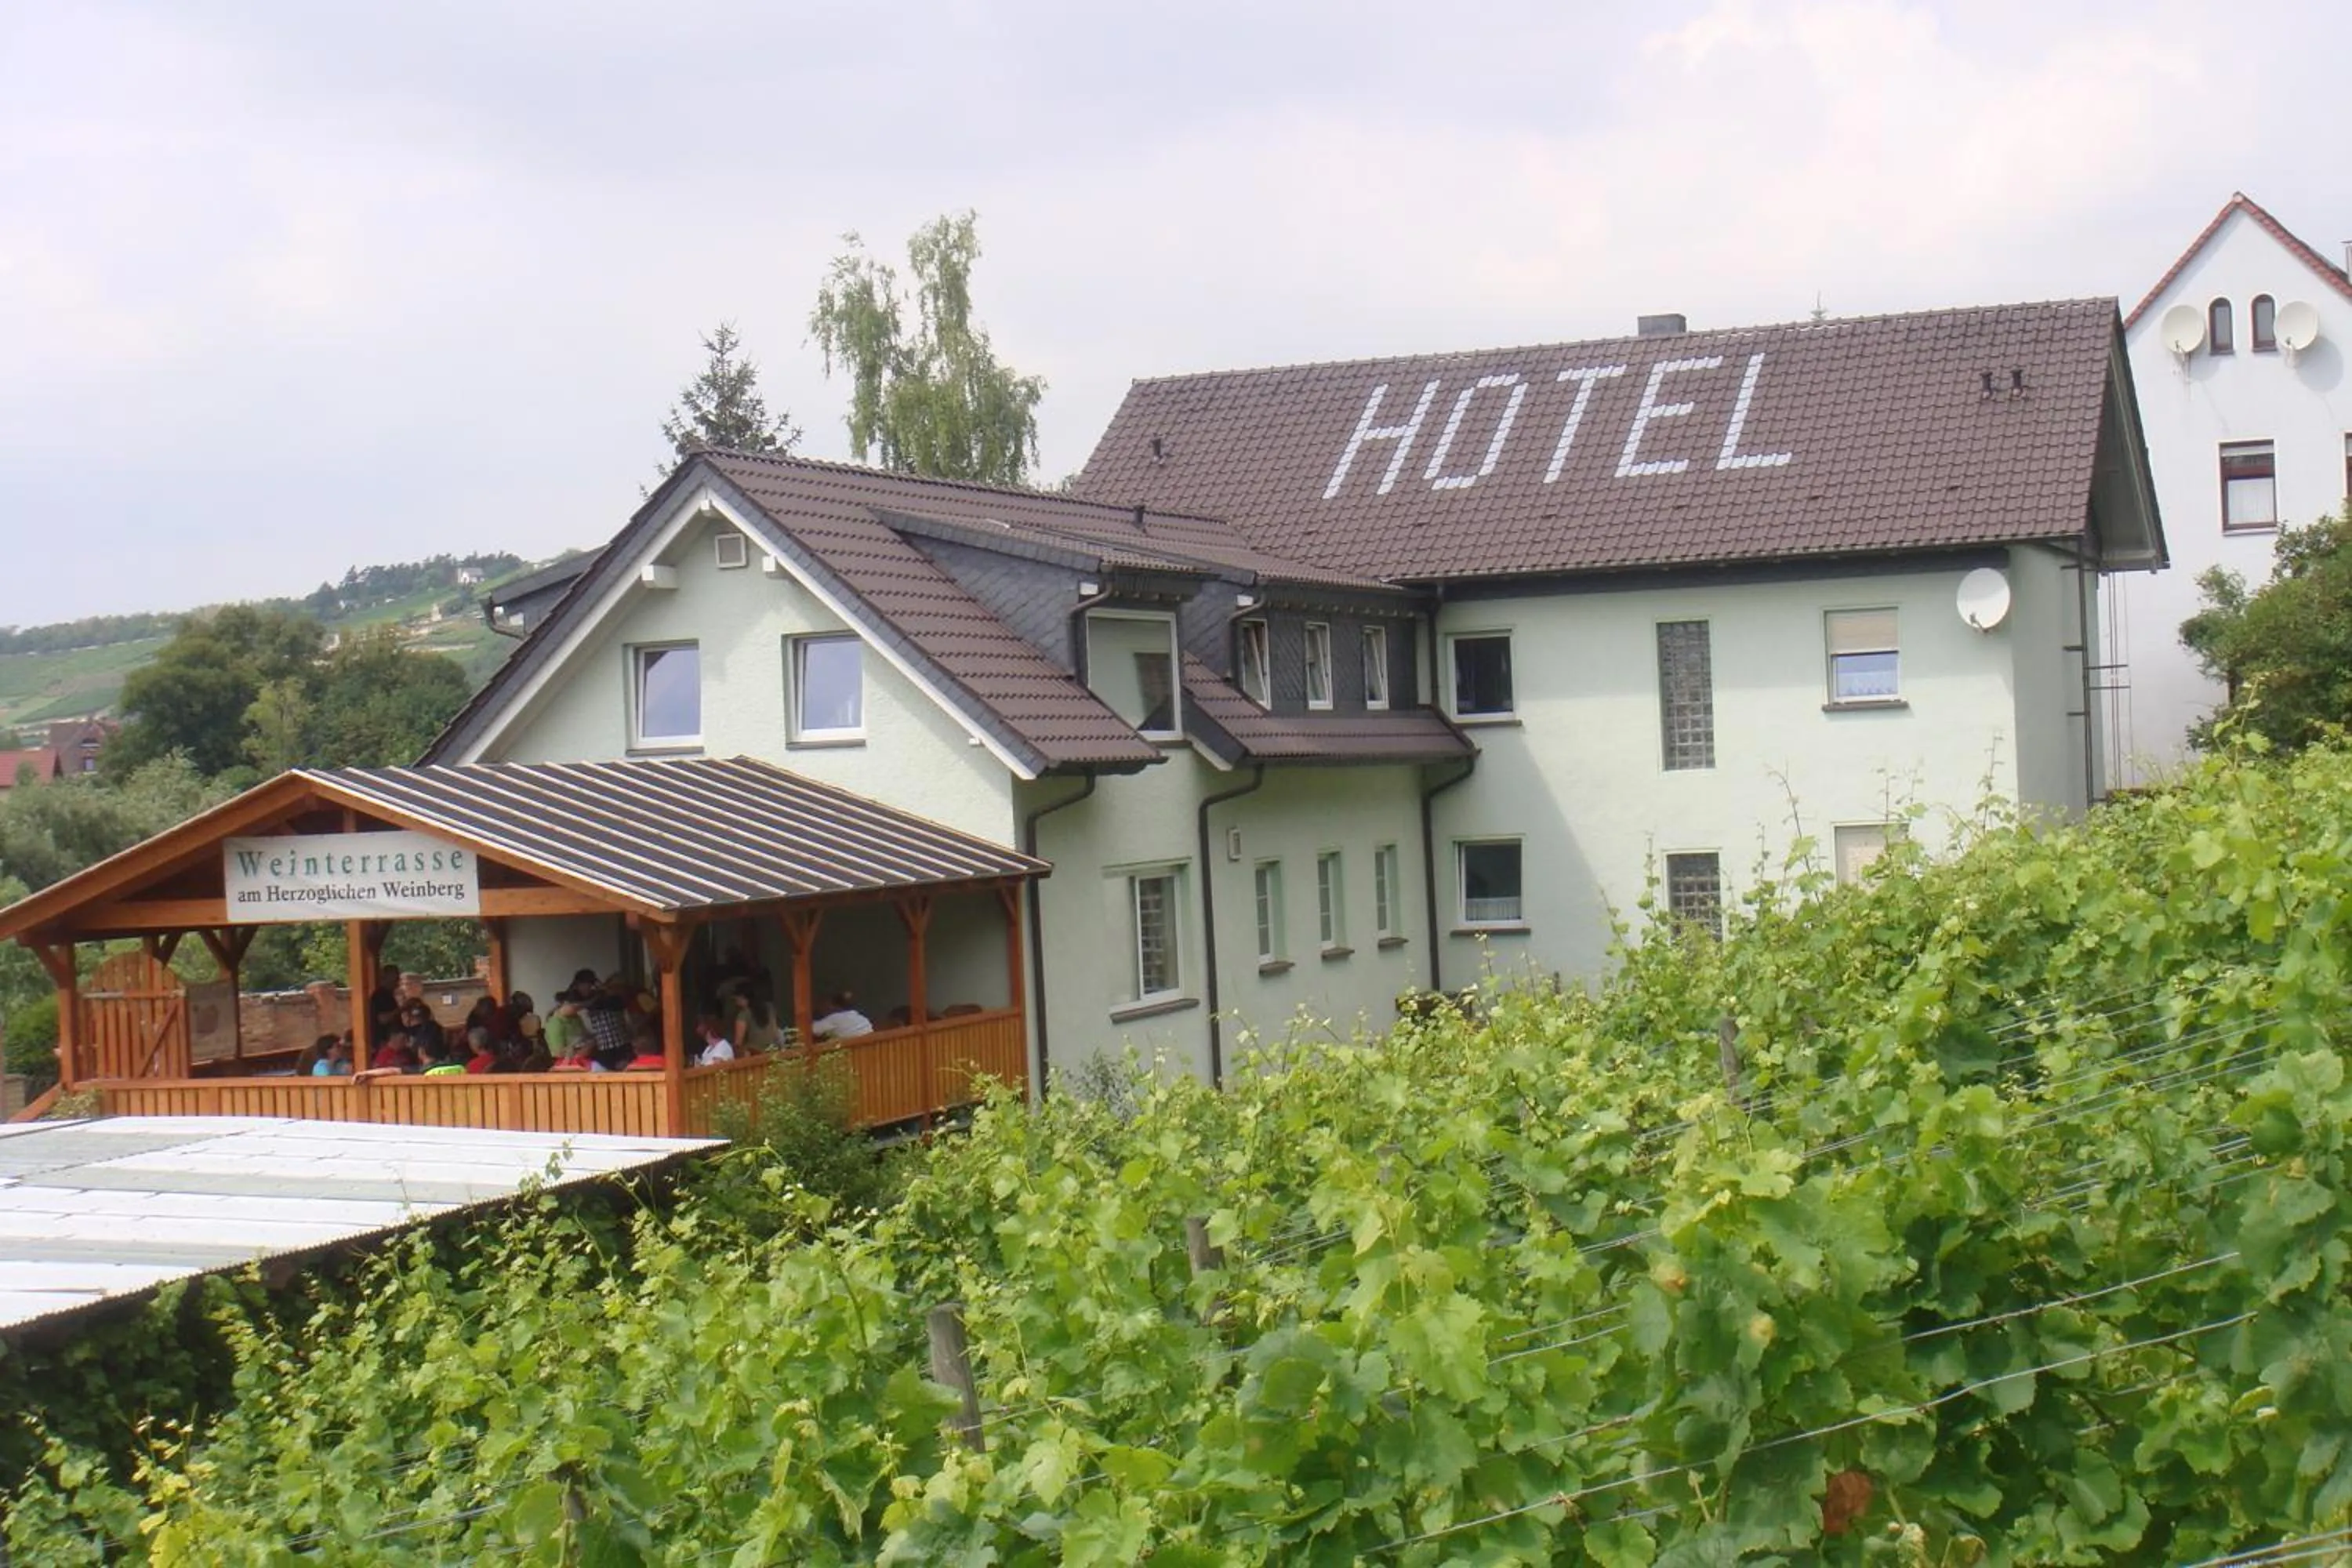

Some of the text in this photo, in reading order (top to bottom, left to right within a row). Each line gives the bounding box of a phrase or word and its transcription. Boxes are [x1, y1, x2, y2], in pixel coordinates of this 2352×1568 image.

[1322, 353, 1792, 499] HOTEL
[237, 849, 463, 879] Weinterrasse
[238, 880, 464, 904] am Herzoglichen Weinberg
